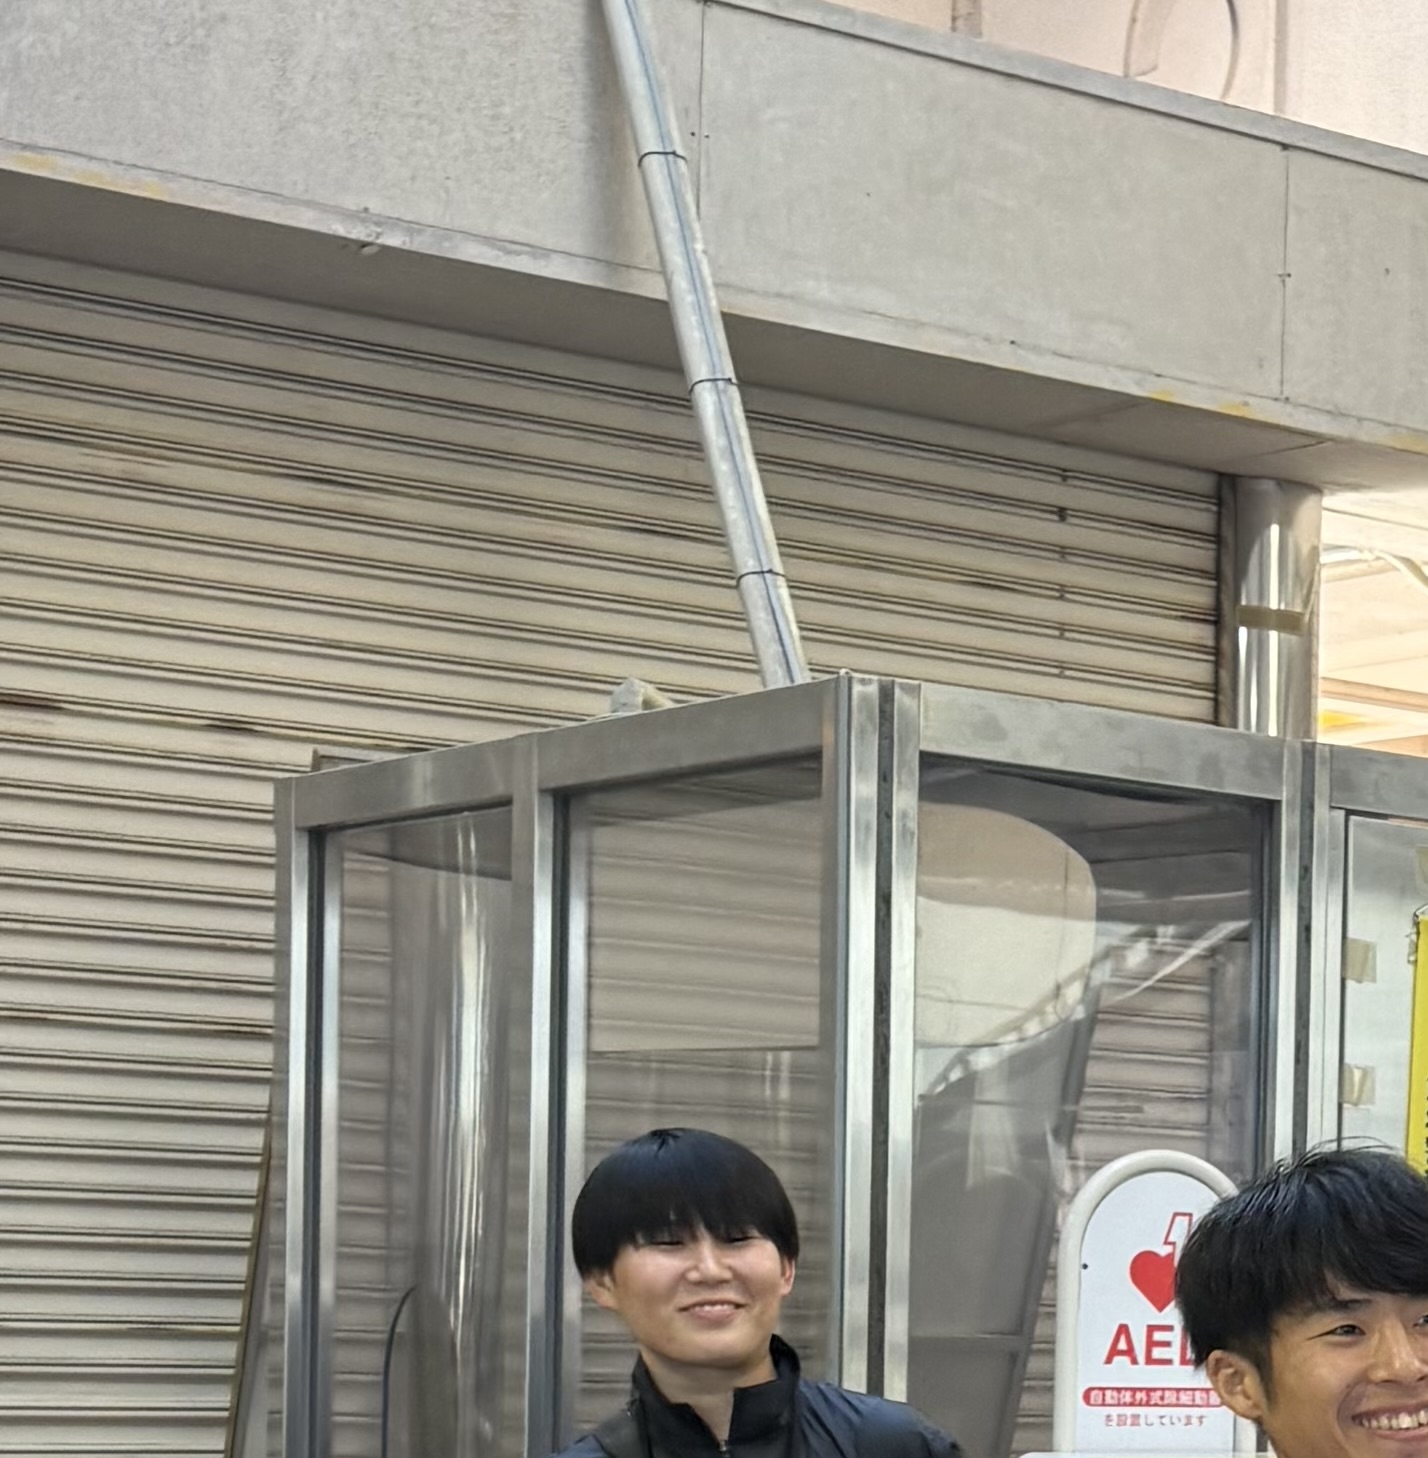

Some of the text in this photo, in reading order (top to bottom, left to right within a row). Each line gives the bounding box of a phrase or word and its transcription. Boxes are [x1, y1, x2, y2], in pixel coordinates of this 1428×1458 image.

[1104, 1413, 1207, 1428] を設置しています
